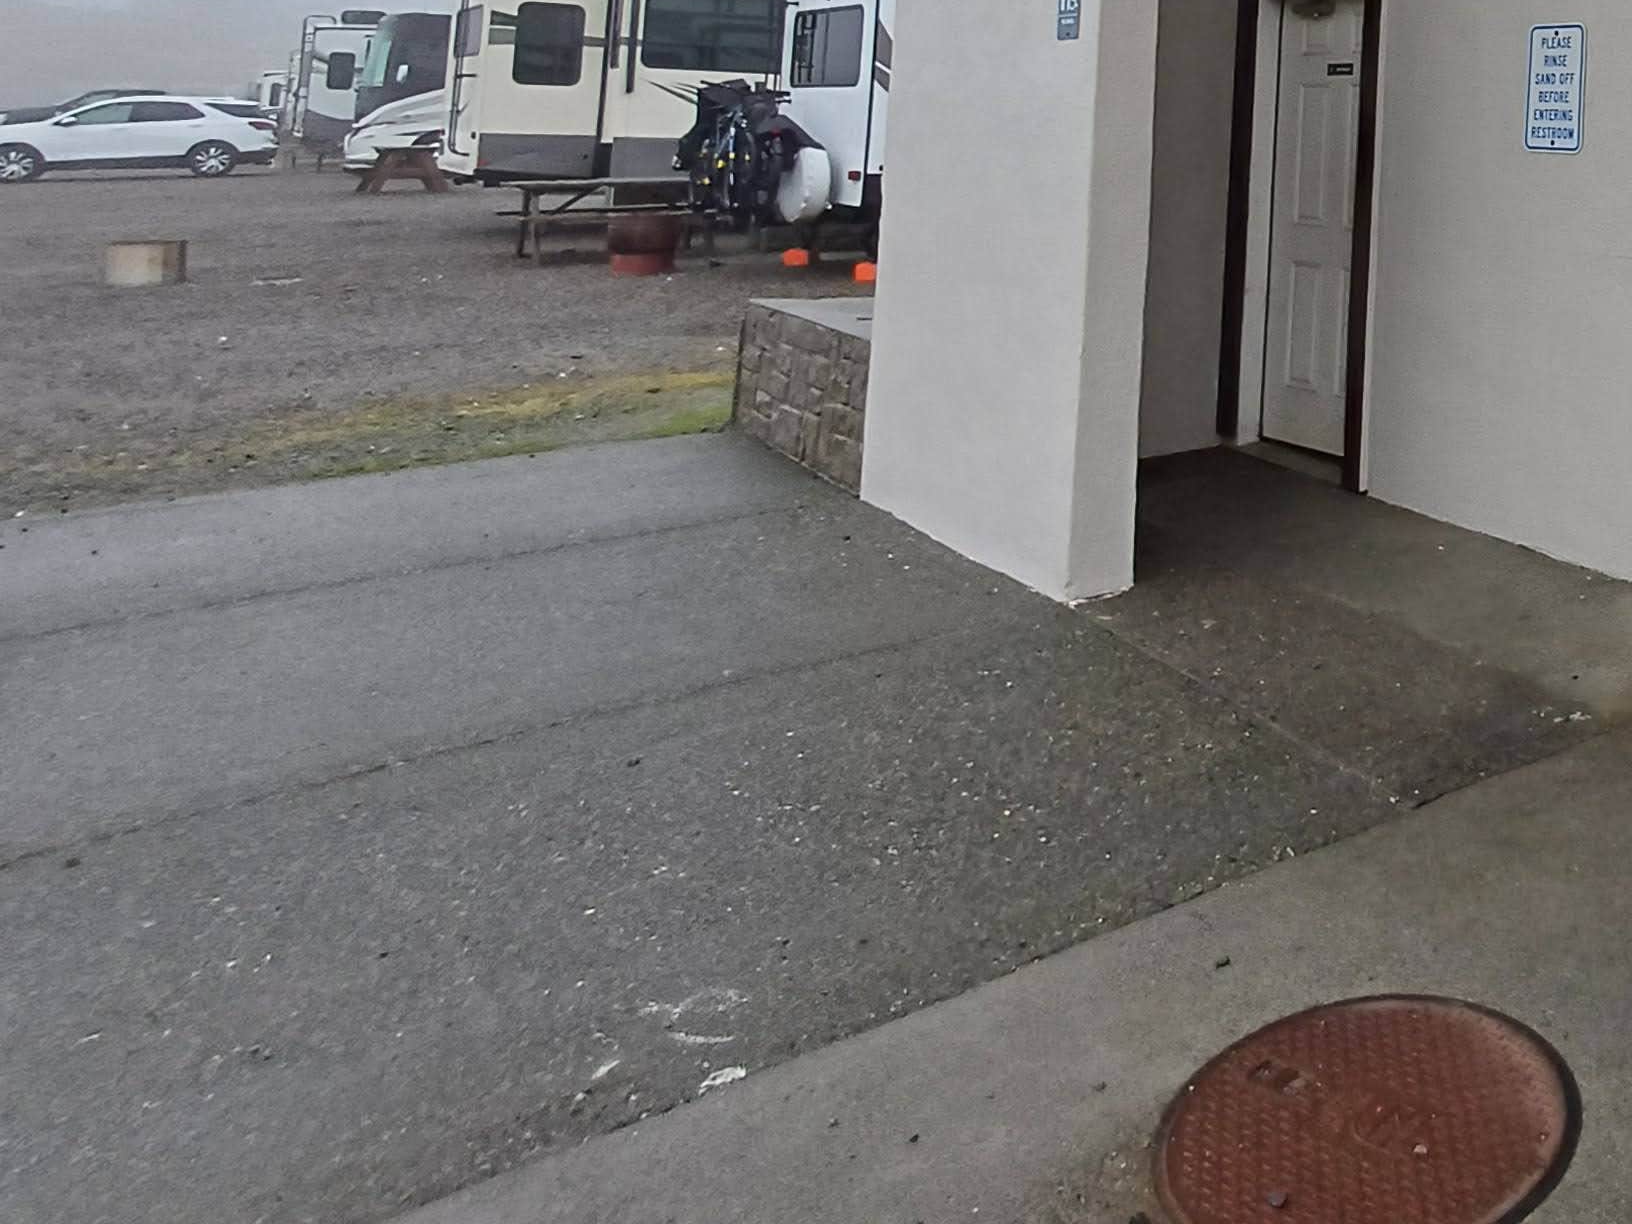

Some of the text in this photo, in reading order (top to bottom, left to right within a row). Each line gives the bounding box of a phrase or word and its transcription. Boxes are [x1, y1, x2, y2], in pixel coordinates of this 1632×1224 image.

[1541, 36, 1572, 49] PLEASE
[1544, 55, 1567, 67] RINSE
[1535, 73, 1575, 85] SAND OFF
[1538, 91, 1569, 103] BEFORE
[1534, 109, 1573, 121] ENTERING
[1531, 127, 1575, 139] RESTROOM
